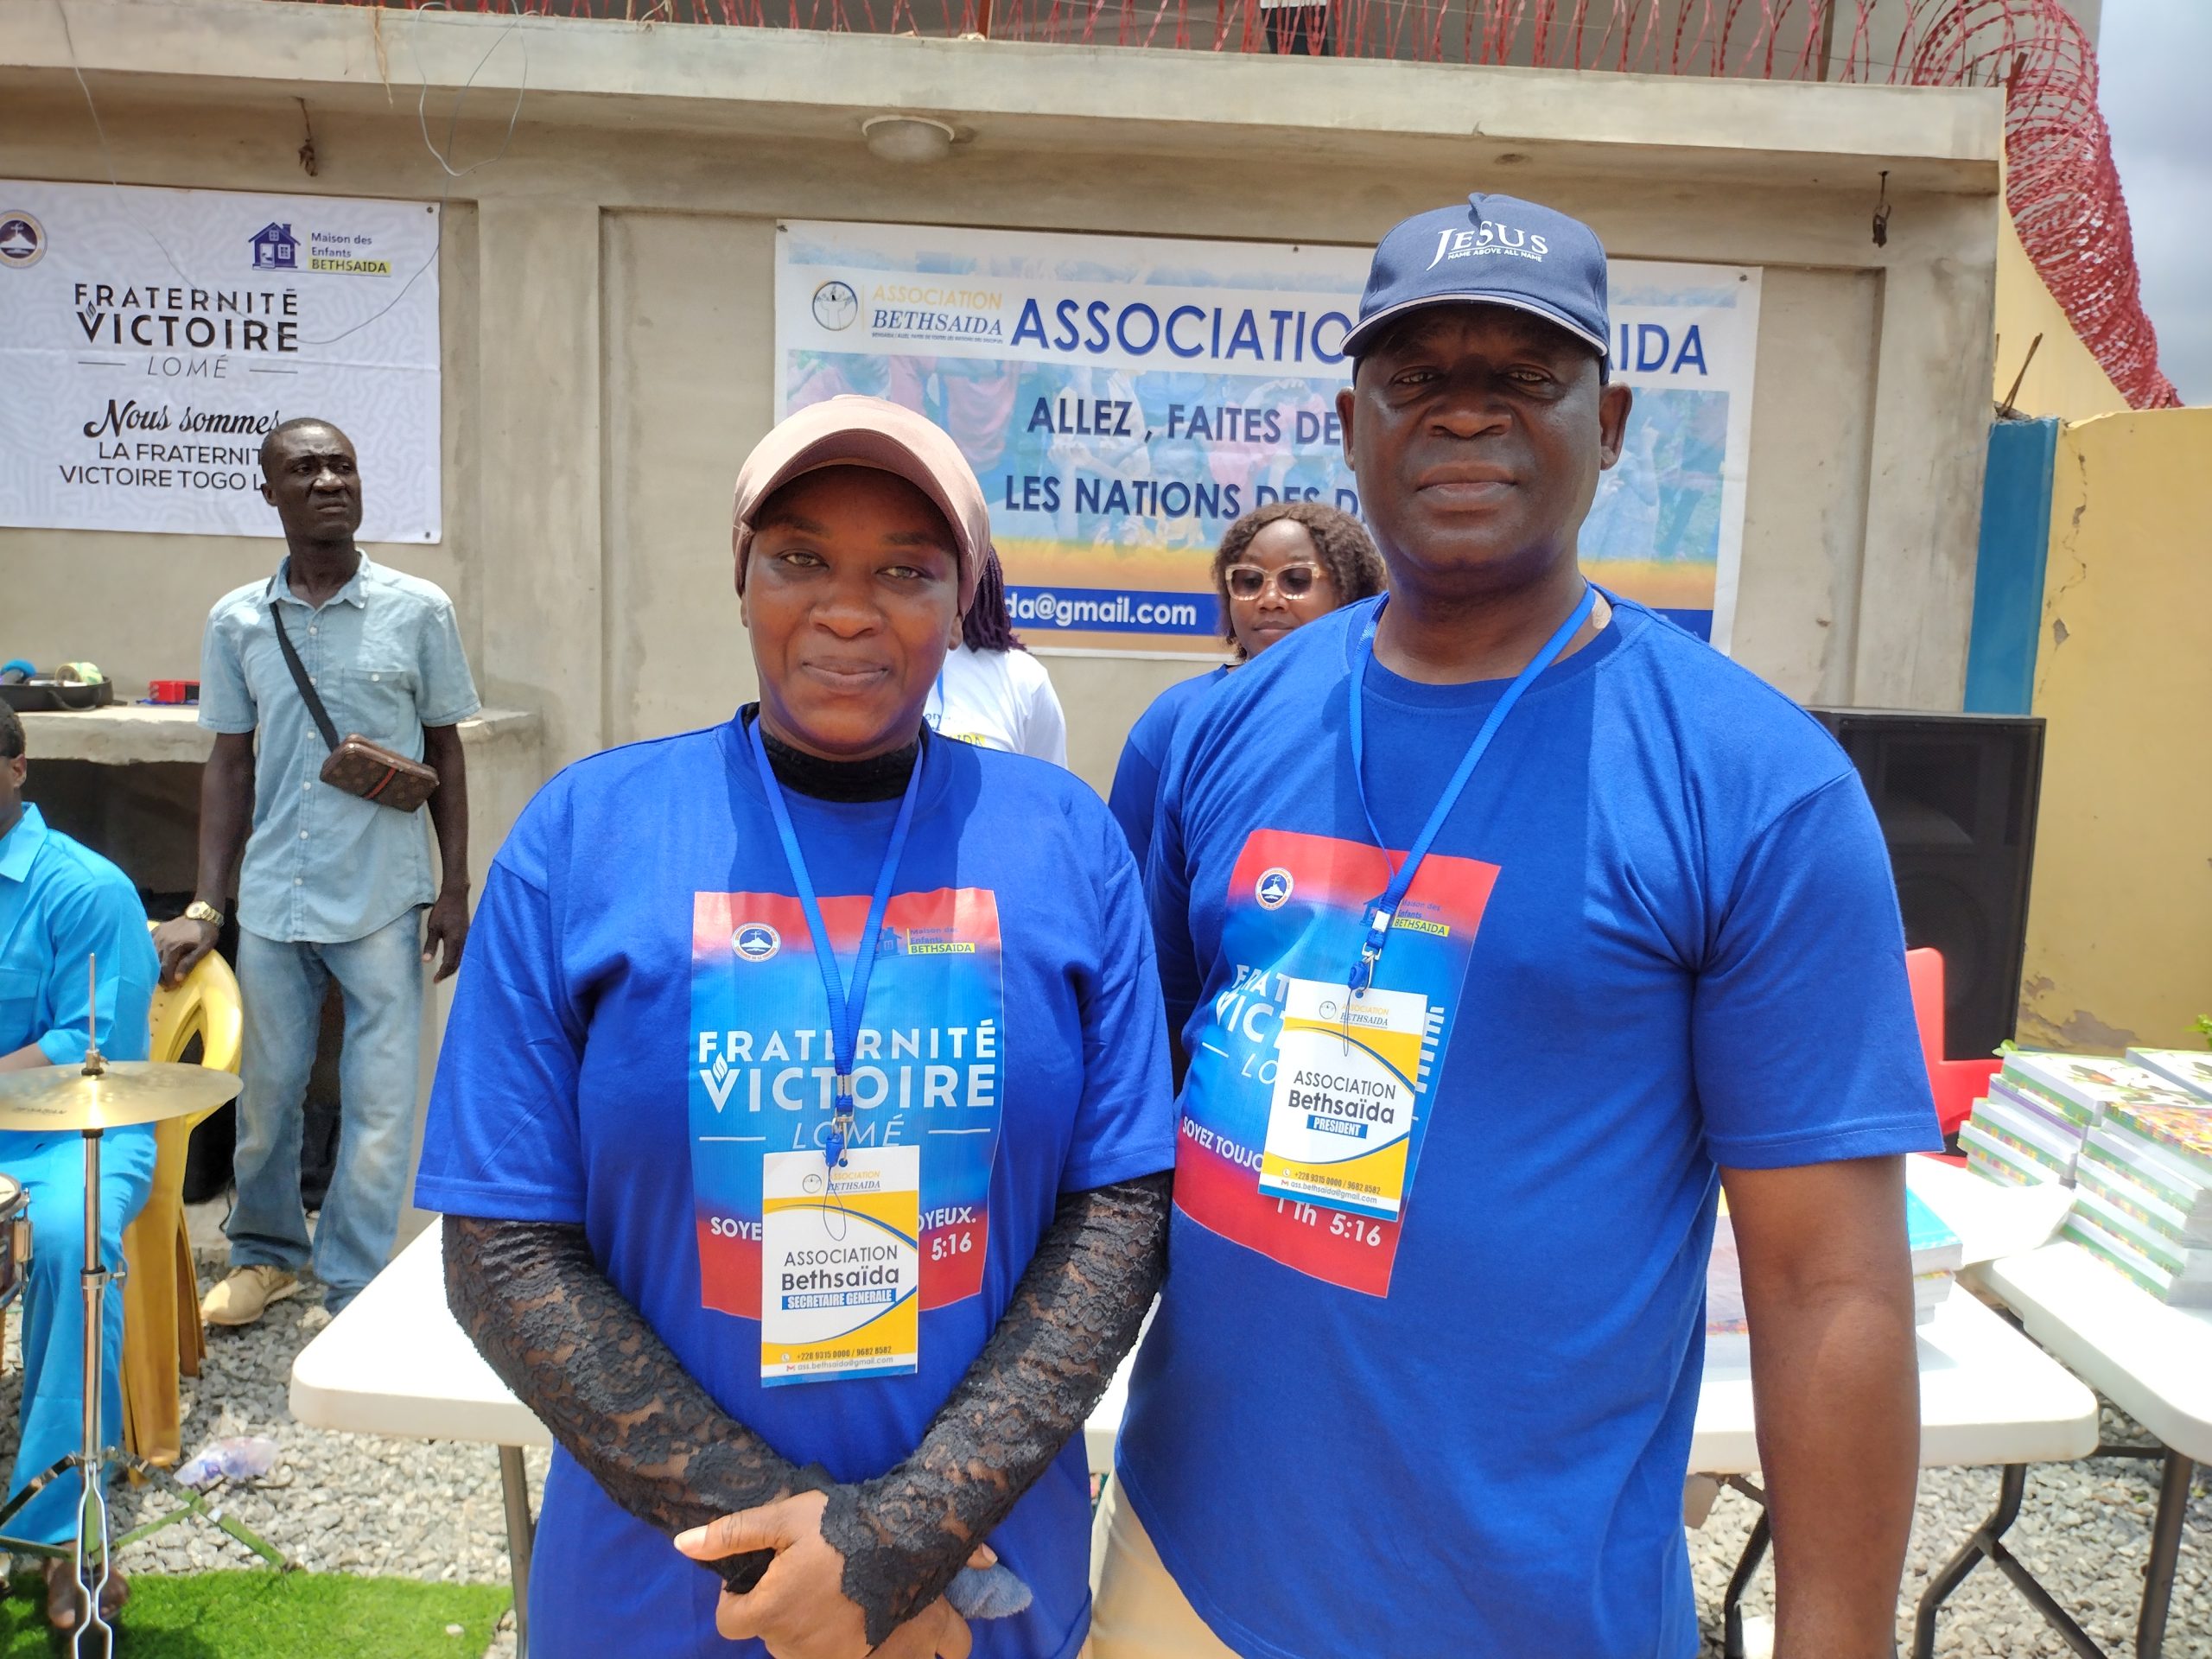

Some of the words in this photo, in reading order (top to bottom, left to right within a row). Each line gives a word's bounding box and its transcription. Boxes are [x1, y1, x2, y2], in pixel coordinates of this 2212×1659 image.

[311, 232, 351, 244] Maison
[354, 234, 372, 245] des
[1426, 221, 1548, 271] JESUS
[311, 247, 352, 258] Enfants
[1447, 251, 1471, 260] NAME
[1473, 247, 1502, 256] ABOVE
[1521, 251, 1542, 263] NAME
[312, 259, 387, 274] BETHSAIDA
[74, 283, 298, 316] FRATERNITÉ
[873, 284, 1003, 311] ASSOCIATION
[76, 311, 299, 353] VICTOIRE
[873, 309, 1003, 336] BETHSAIDA
[1010, 298, 1353, 365] ASSOCIATIO
[147, 354, 229, 379] LOMÉ
[83, 399, 172, 438] Nous
[179, 406, 280, 435] sommes
[1027, 397, 1133, 437] ALLEZ
[1167, 404, 1281, 443] FAITES
[1296, 410, 1341, 446] DE
[99, 442, 130, 460] LA
[137, 443, 262, 466] FRATERNIT
[60, 465, 172, 487] VICTOIRE
[177, 470, 246, 490] TOGO
[1006, 475, 1060, 513] LES
[1075, 478, 1241, 518] NATIONS
[1005, 592, 1196, 627] da@gmail.com
[1394, 918, 1445, 935] BETHSAIDA
[911, 944, 972, 954] BETHSAIDA
[699, 1065, 995, 1114] VICTOIRE
[1294, 1070, 1396, 1100] ASSOCIATION
[1288, 1089, 1395, 1124] Bethsaïda
[1313, 1116, 1362, 1136] PRESIDENT
[1182, 1116, 1214, 1150] SOYEZ
[1216, 1135, 1263, 1173] TOUJO
[1294, 1171, 1310, 1181] +228
[1311, 1173, 1325, 1184] 9315
[1326, 1177, 1343, 1187] 0000
[710, 1216, 762, 1242] SOYE
[1330, 1212, 1382, 1247] 5:16
[785, 1244, 898, 1267] ASSOCIATION
[931, 1231, 972, 1262] 5:16
[782, 1265, 899, 1291] Bethsaïda
[787, 1292, 845, 1310] SECRETAIRE
[846, 1289, 893, 1306] GENERALE
